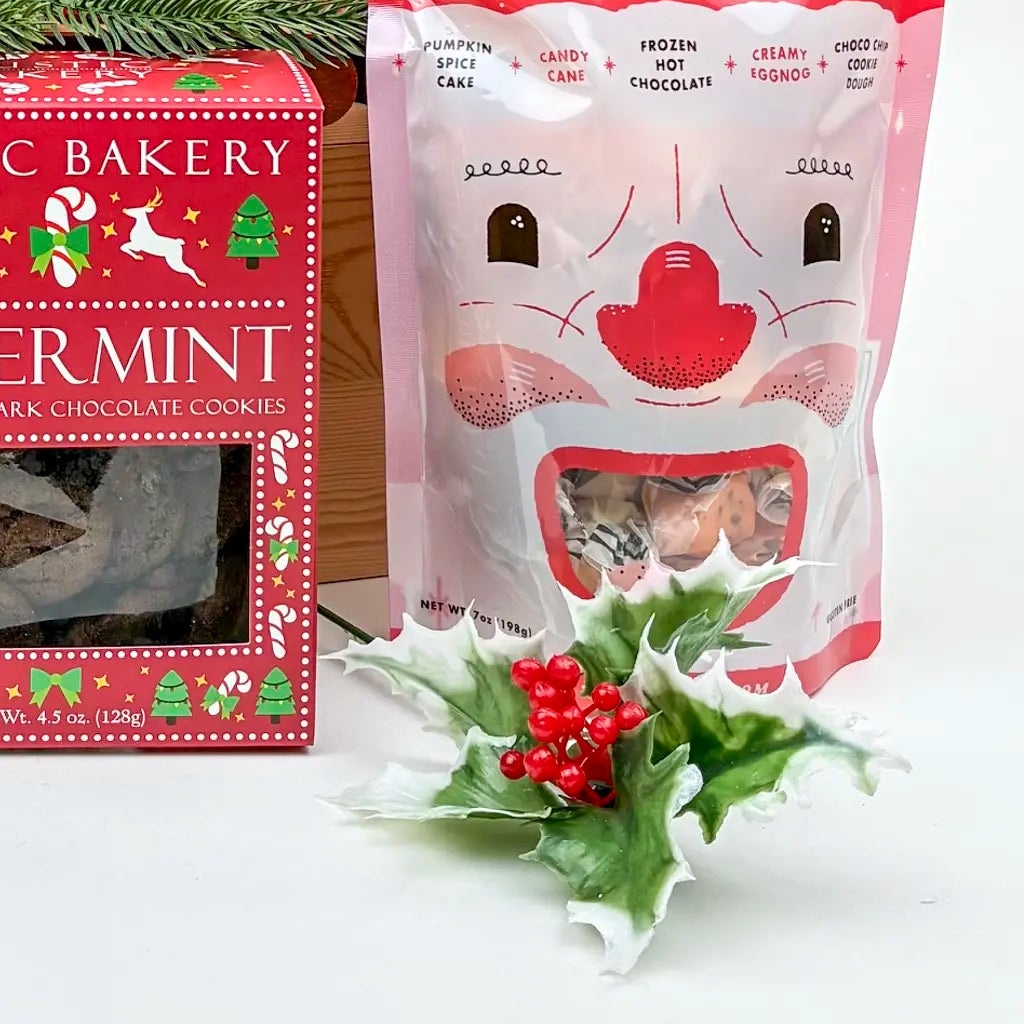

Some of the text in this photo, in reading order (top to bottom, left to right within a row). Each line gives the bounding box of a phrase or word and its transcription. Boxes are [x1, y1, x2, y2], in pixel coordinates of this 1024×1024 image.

[423, 39, 492, 54] PUMPKIN
[640, 39, 697, 52] FROZEN
[834, 38, 889, 53] CHOCO CHIP
[539, 49, 589, 63] CANDY
[752, 46, 808, 61] CREAMY
[436, 57, 477, 70] SPICE
[655, 59, 685, 72] HOT
[847, 58, 878, 71] COOKIE
[437, 75, 475, 89] CAKE
[547, 69, 585, 84] CANE
[750, 68, 811, 83] EGGNOG
[630, 76, 713, 92] CHOCOLATE
[845, 77, 874, 90] DOUGH
[64, 139, 291, 176] BAKERY
[50, 399, 183, 418] CHOCOLATE
[189, 398, 286, 416] COOKIES
[420, 599, 444, 613] NET
[0, 709, 32, 725] Wt.
[37, 709, 61, 725] 4.5
[66, 713, 90, 725] oz.
[95, 708, 146, 728] (128g)
